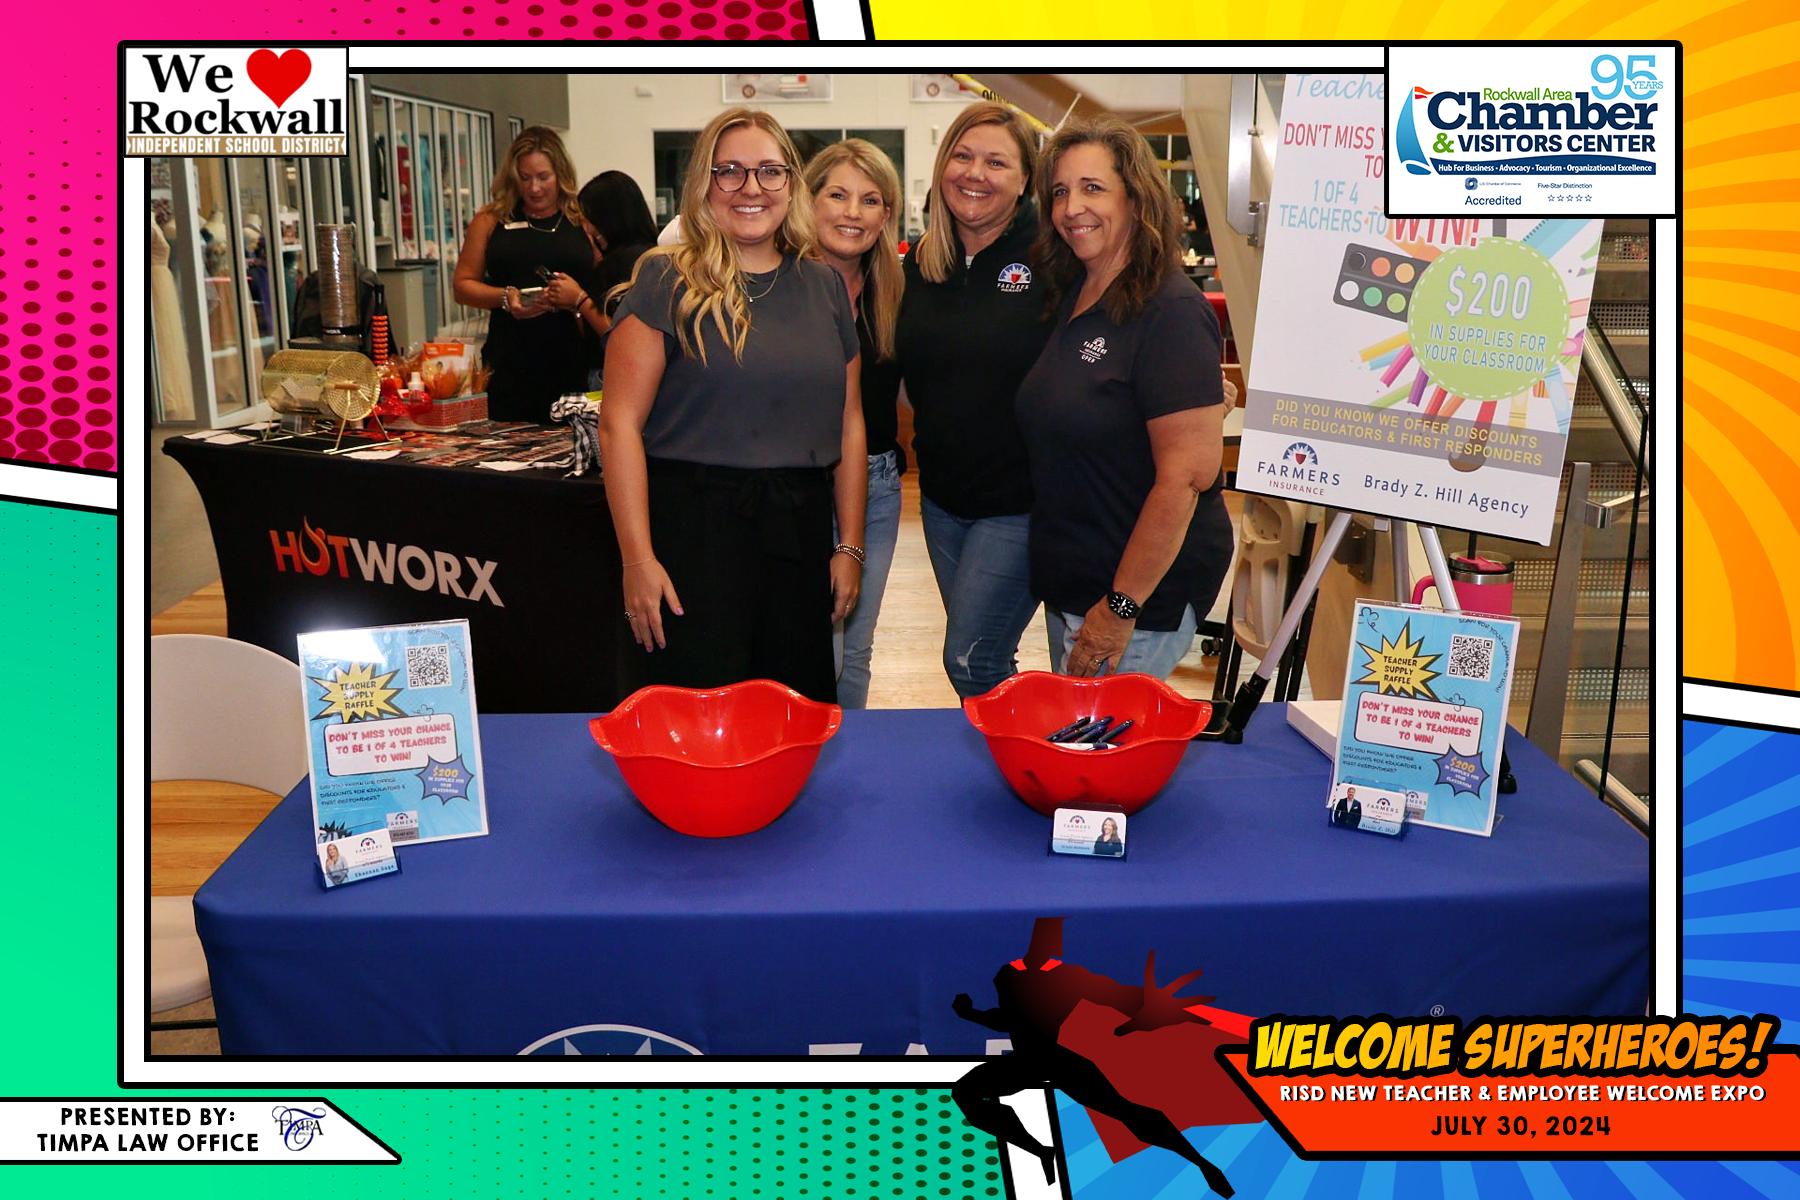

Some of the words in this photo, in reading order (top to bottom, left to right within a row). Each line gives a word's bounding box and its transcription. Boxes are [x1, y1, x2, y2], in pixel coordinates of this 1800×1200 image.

[1284, 123, 1332, 147] DON'T
[1335, 125, 1375, 150] MISS
[1365, 155, 1384, 178] TO
[1314, 180, 1319, 201] 1
[1324, 181, 1345, 203] OF
[1349, 182, 1358, 204] 4
[1280, 205, 1362, 233] TEACHERS
[1368, 211, 1387, 235] TO
[1446, 264, 1531, 320] $200
[1430, 323, 1444, 339] IN
[1449, 325, 1514, 348] SUPPLIES
[1520, 334, 1546, 352] FOR
[1425, 344, 1457, 362] YOUR
[1463, 348, 1544, 372] CLASSROOM
[1276, 400, 1298, 412] DID
[1304, 403, 1330, 417] YOU
[1335, 408, 1374, 423] KNOW
[1379, 413, 1400, 428] WE
[1404, 417, 1449, 435] OFFER
[1455, 426, 1538, 449] DISCOUNTS
[1272, 414, 1298, 428] FOR
[1303, 419, 1382, 441] EDUCATORS
[1387, 431, 1396, 442] &
[1400, 433, 1440, 449] FIRST
[1445, 440, 1543, 466] RESPONDERS
[1257, 461, 1341, 486] FARMERS
[1269, 480, 1325, 496] INSURANCE
[1364, 474, 1409, 498] Brady
[1415, 483, 1428, 498] Z.
[1435, 487, 1463, 504] Hill
[1468, 492, 1529, 518] Agency
[269, 516, 505, 608] HOTWORX
[1383, 655, 1417, 666] TEACHER
[1384, 665, 1413, 675] SUPPLY
[340, 680, 376, 691] TEACHER
[1384, 674, 1411, 684] RAFFLE
[345, 700, 374, 709] RAFFLE
[1362, 700, 1389, 712] DON'T
[1392, 705, 1414, 716] MISS
[1418, 709, 1440, 720] YOUR
[1444, 713, 1479, 725] CHANCE
[329, 731, 358, 742] DON'T
[361, 729, 384, 740] MISS
[388, 727, 412, 737] YOUR
[416, 723, 451, 733] CHANCE
[1366, 714, 1378, 722] TO
[1380, 716, 1392, 725] BE
[1394, 716, 1398, 725] 1
[1401, 719, 1413, 728] OF
[1415, 722, 1423, 730] 4
[1426, 723, 1472, 737] TEACHERS
[336, 745, 348, 754] TO
[352, 744, 365, 753] BE
[367, 744, 371, 752] 1
[374, 742, 386, 751] OF
[400, 736, 447, 748] TEACHERS
[1399, 731, 1410, 740] TO
[1414, 733, 1434, 744] WIN!
[374, 754, 387, 763] TO
[390, 751, 411, 761] WIN!
